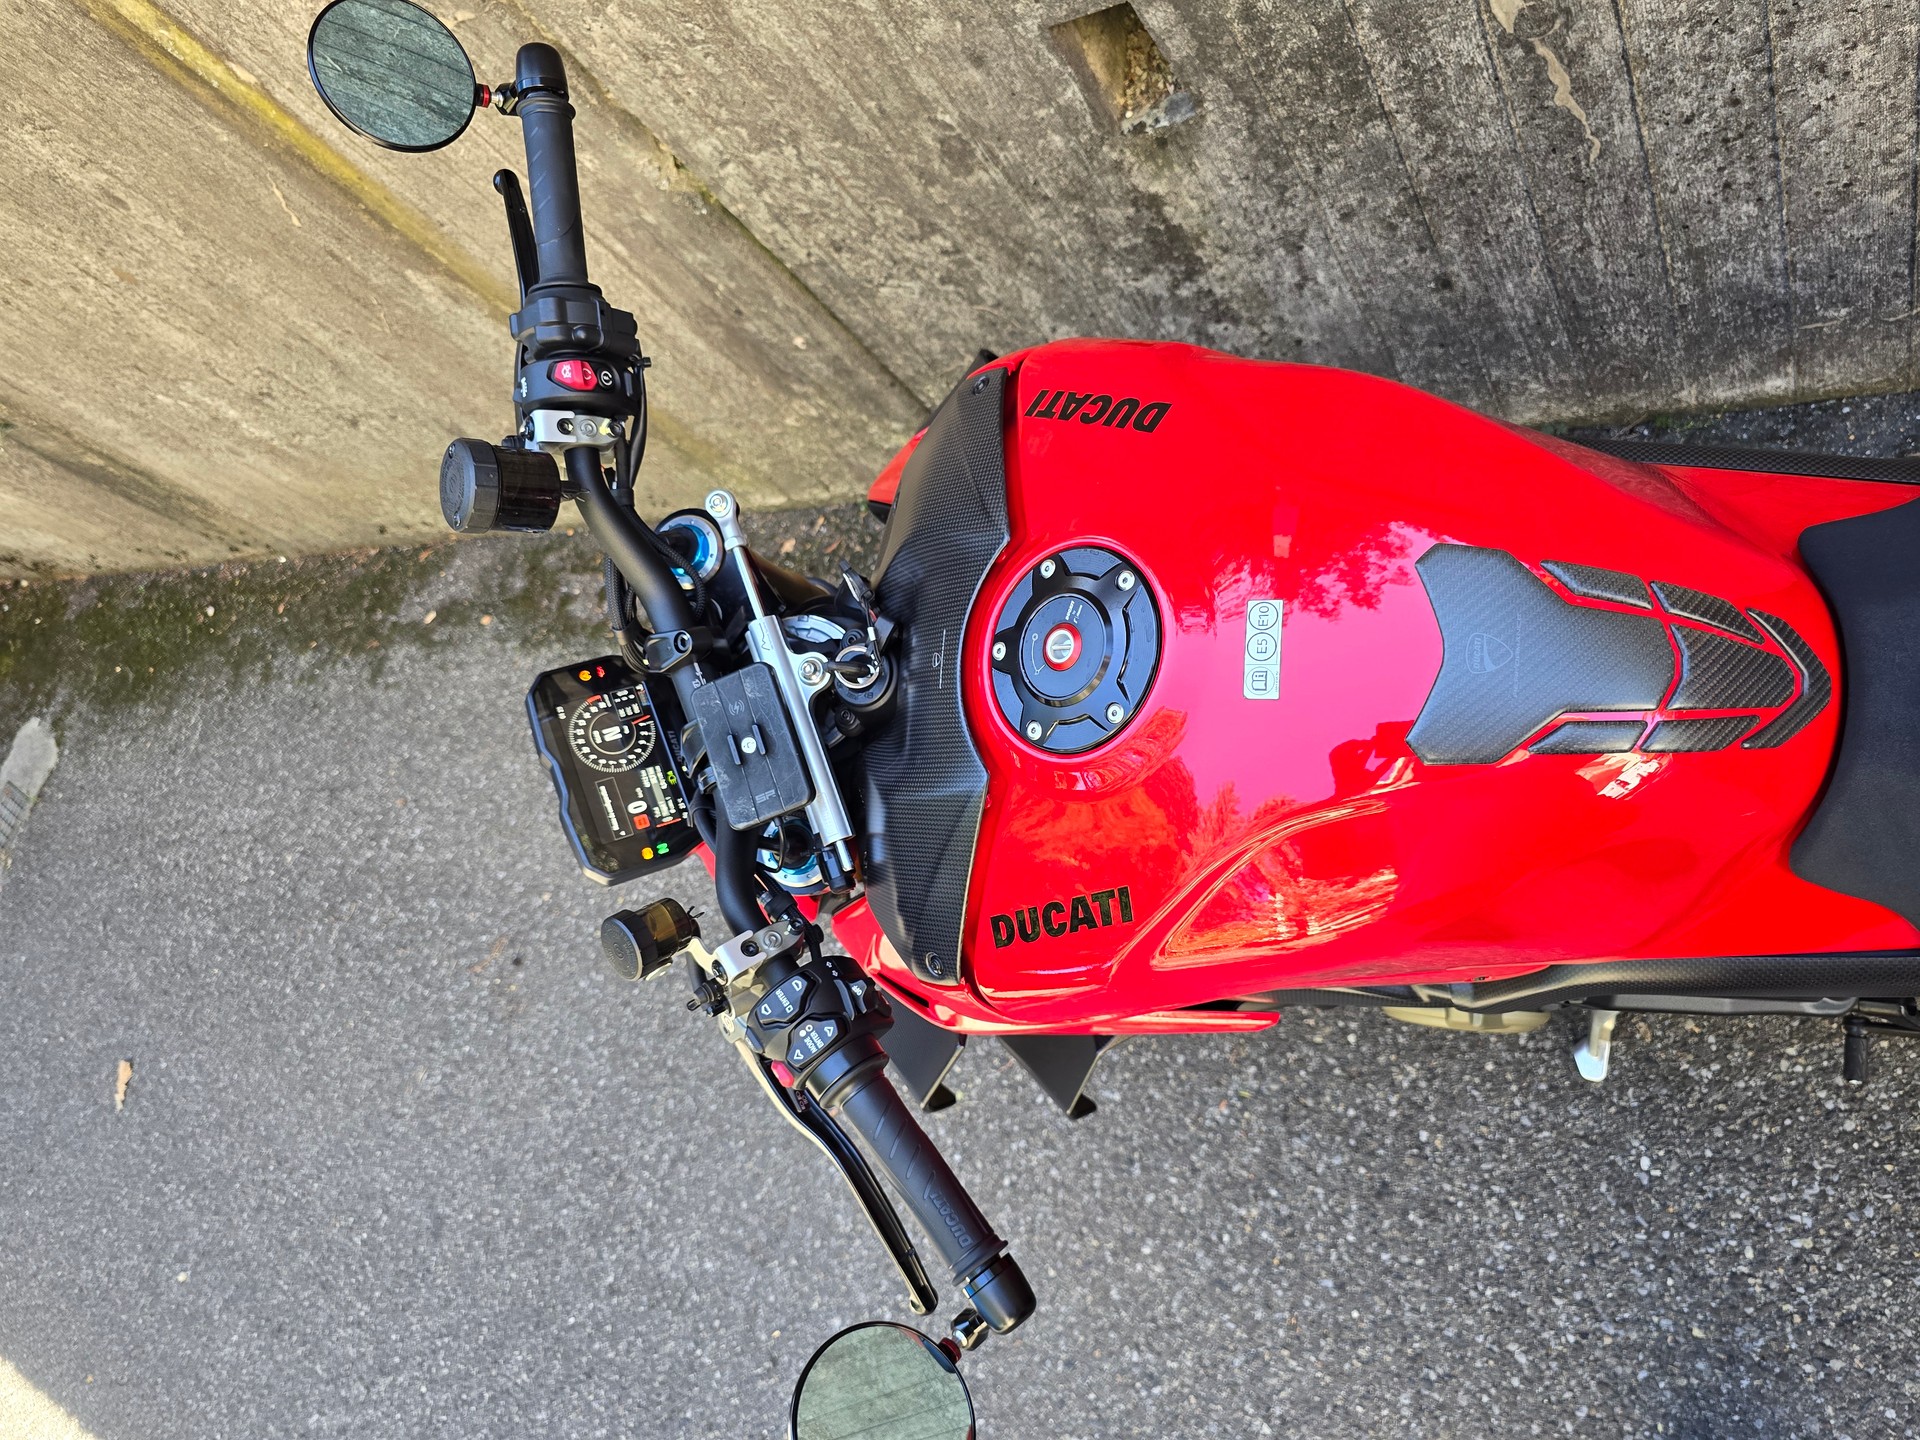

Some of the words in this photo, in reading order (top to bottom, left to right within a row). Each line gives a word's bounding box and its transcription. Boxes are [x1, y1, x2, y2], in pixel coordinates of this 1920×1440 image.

[1024, 389, 1172, 433] DUCATI
[1258, 606, 1269, 627] E10
[1256, 639, 1267, 654] E5
[1473, 637, 1482, 669] DUCATI
[601, 725, 623, 742] N
[627, 800, 648, 814] 0
[657, 842, 669, 855] N
[989, 886, 1134, 949] DUCATI
[775, 989, 790, 1006] ENTER
[852, 985, 863, 995] OFF
[804, 1036, 818, 1053] MODE
[810, 1030, 825, 1049] ENTER
[929, 1193, 973, 1249] DUCATI
